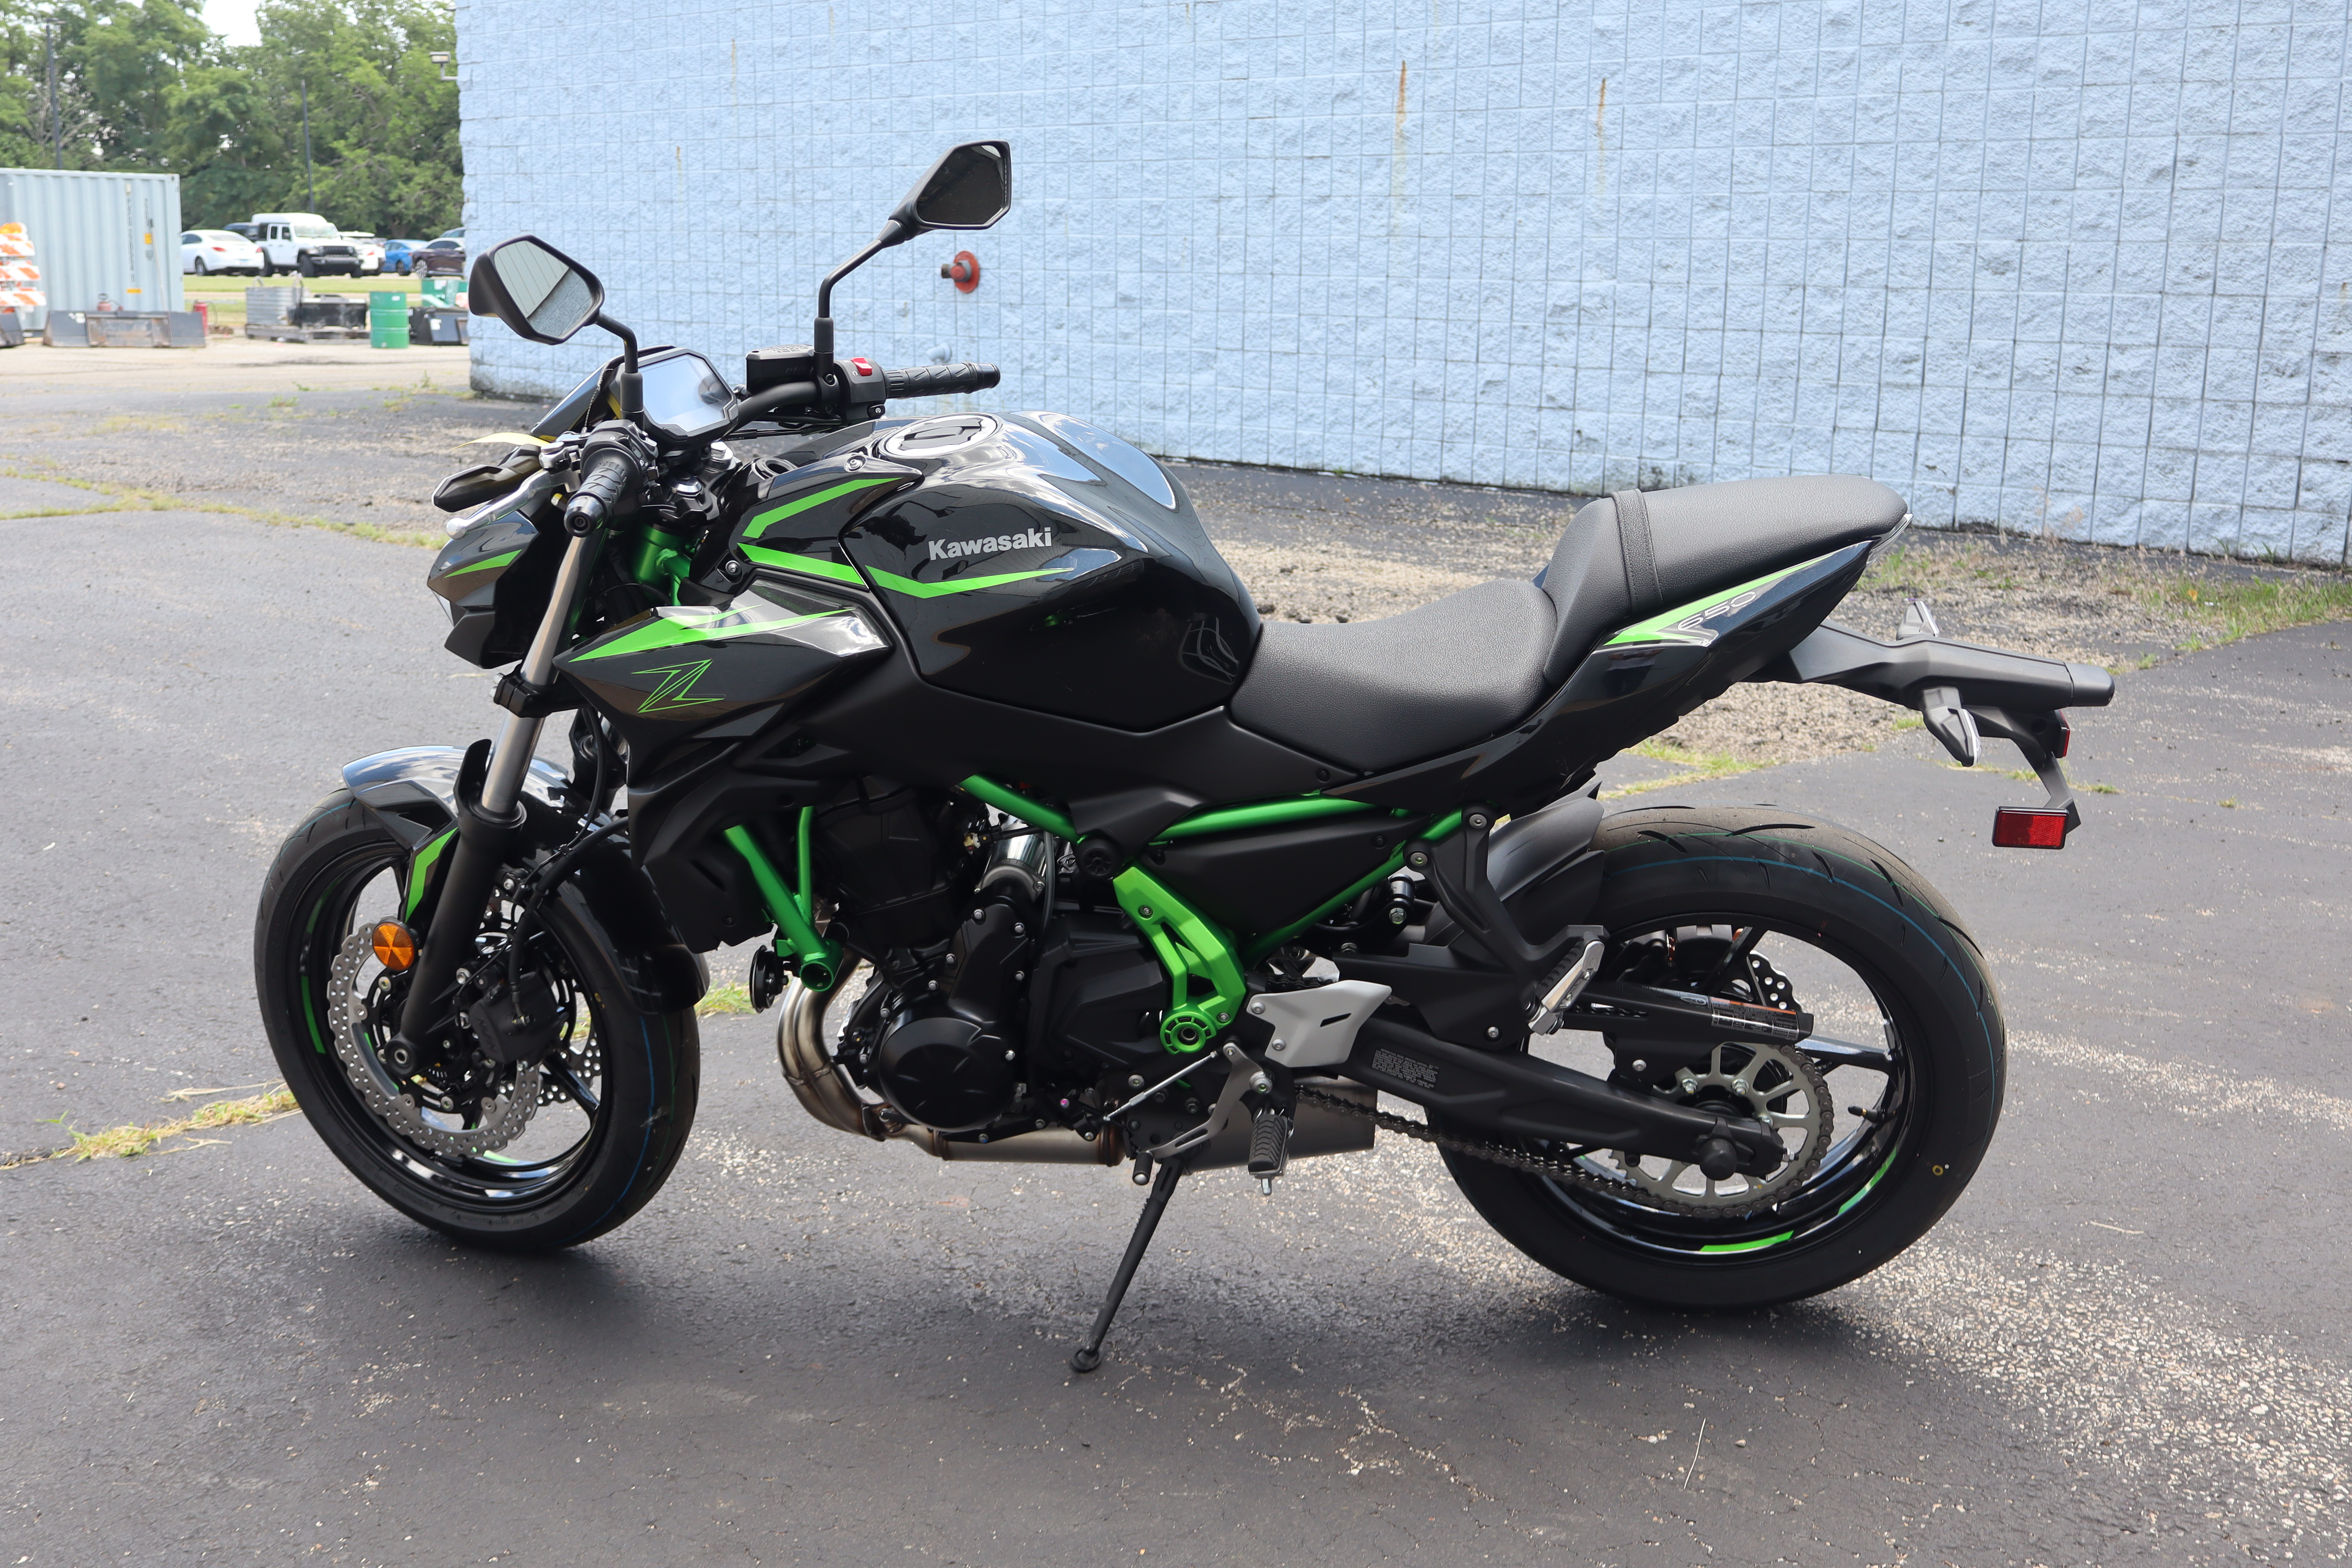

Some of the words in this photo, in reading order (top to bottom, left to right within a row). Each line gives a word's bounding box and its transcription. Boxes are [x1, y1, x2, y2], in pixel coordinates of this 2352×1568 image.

[928, 526, 1053, 561] Kawasaki
[1677, 591, 1757, 632] 650
[631, 659, 725, 713] Z
